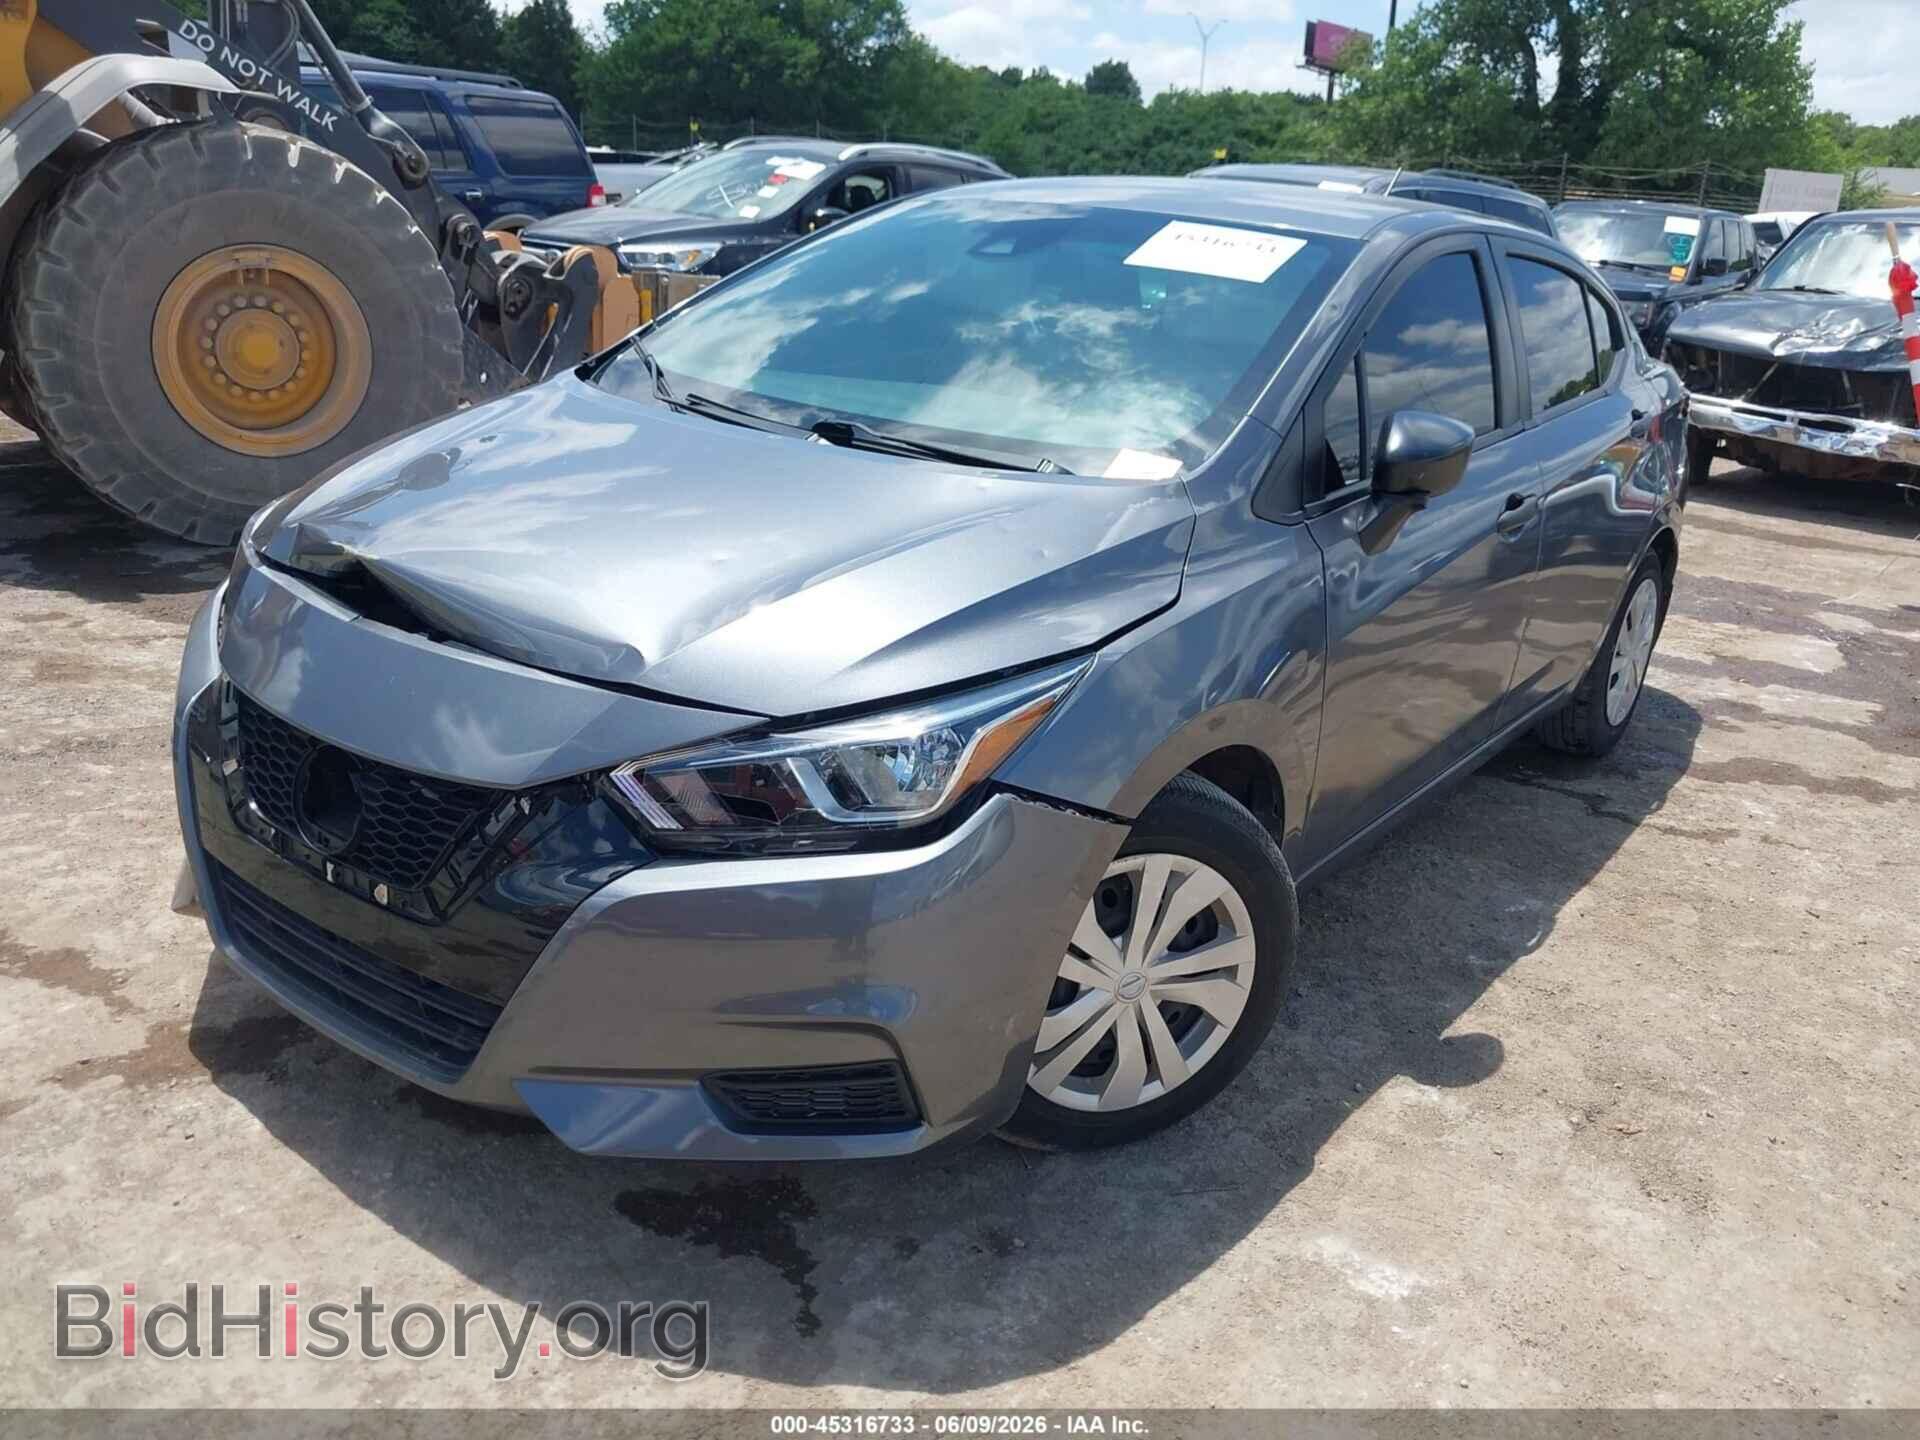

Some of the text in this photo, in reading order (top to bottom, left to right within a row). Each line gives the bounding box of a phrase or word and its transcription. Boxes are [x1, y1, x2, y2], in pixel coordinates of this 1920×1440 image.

[178, 19, 339, 132] DO NOT WALK
